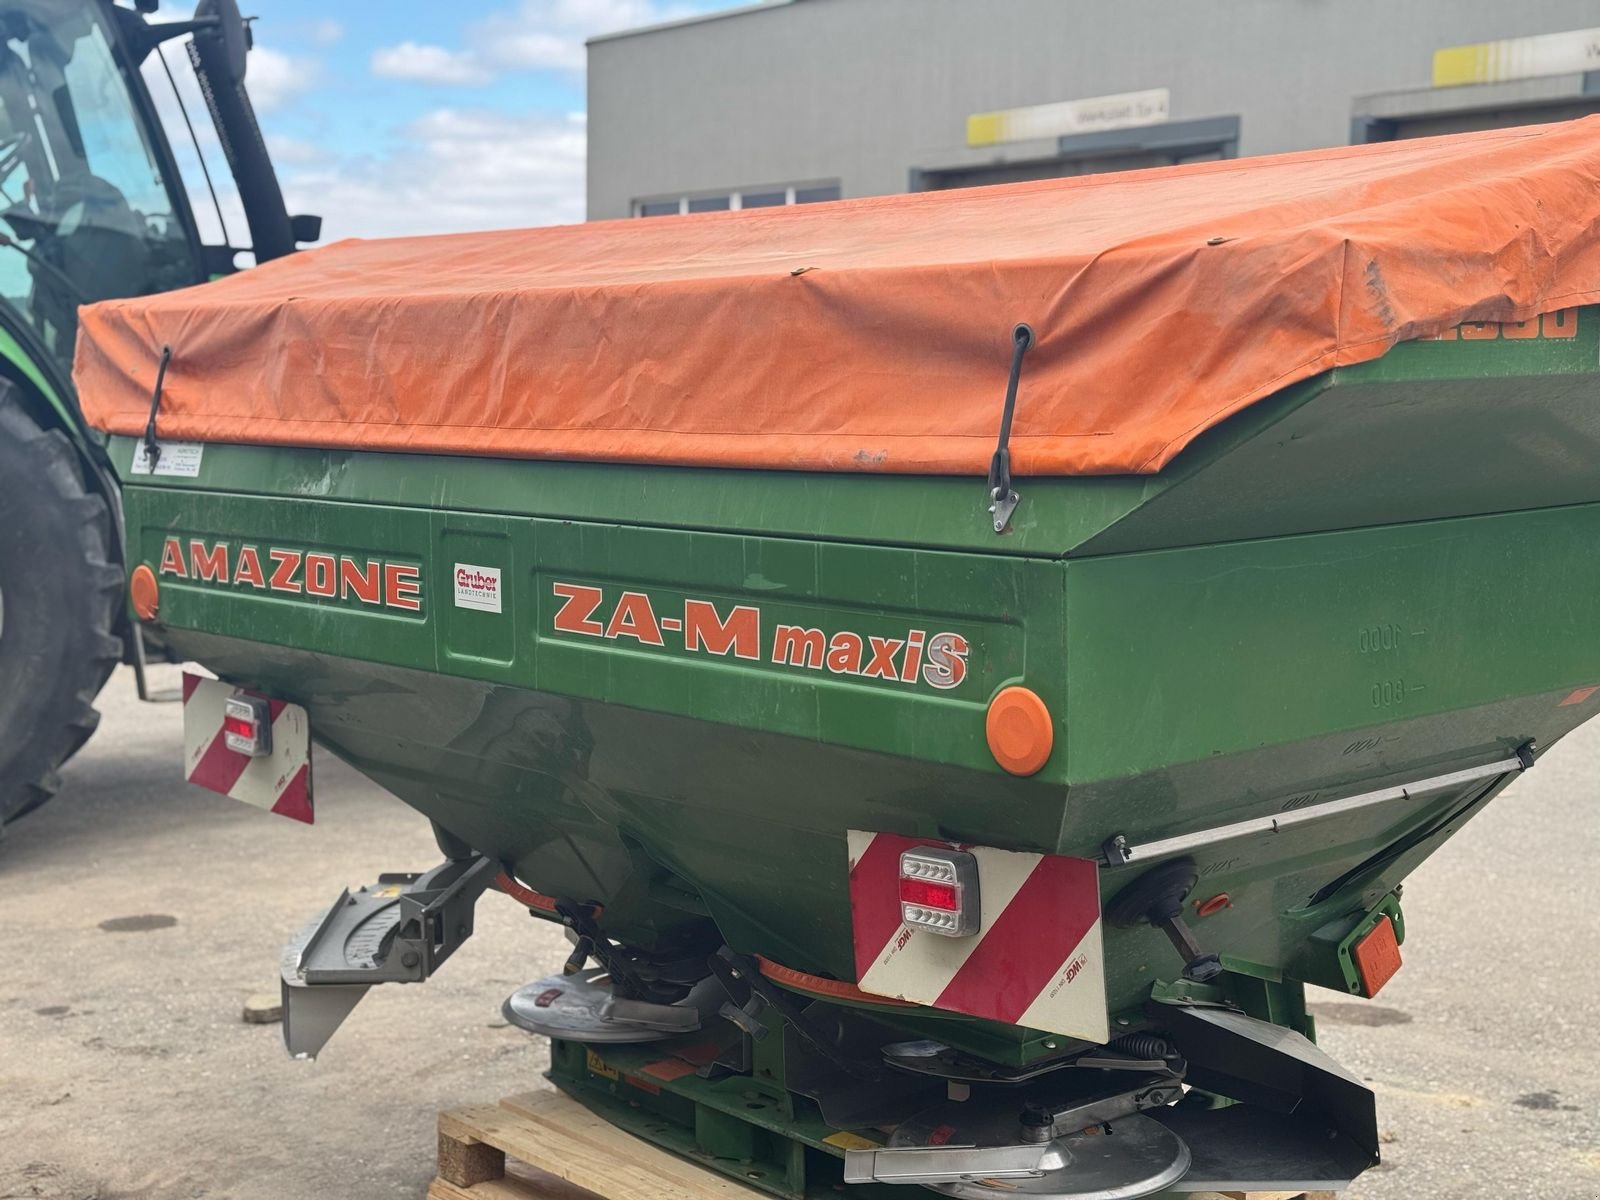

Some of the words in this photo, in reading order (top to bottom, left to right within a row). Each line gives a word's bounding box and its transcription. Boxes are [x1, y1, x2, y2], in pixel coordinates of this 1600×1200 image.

[159, 535, 421, 611] AMAZONE
[457, 568, 497, 592] Gruber
[457, 588, 497, 599] LANDTECHNIK
[553, 582, 760, 661] ZA-M
[772, 622, 969, 689] maxiS
[897, 929, 912, 951] WGF
[1066, 960, 1082, 984] WGF
